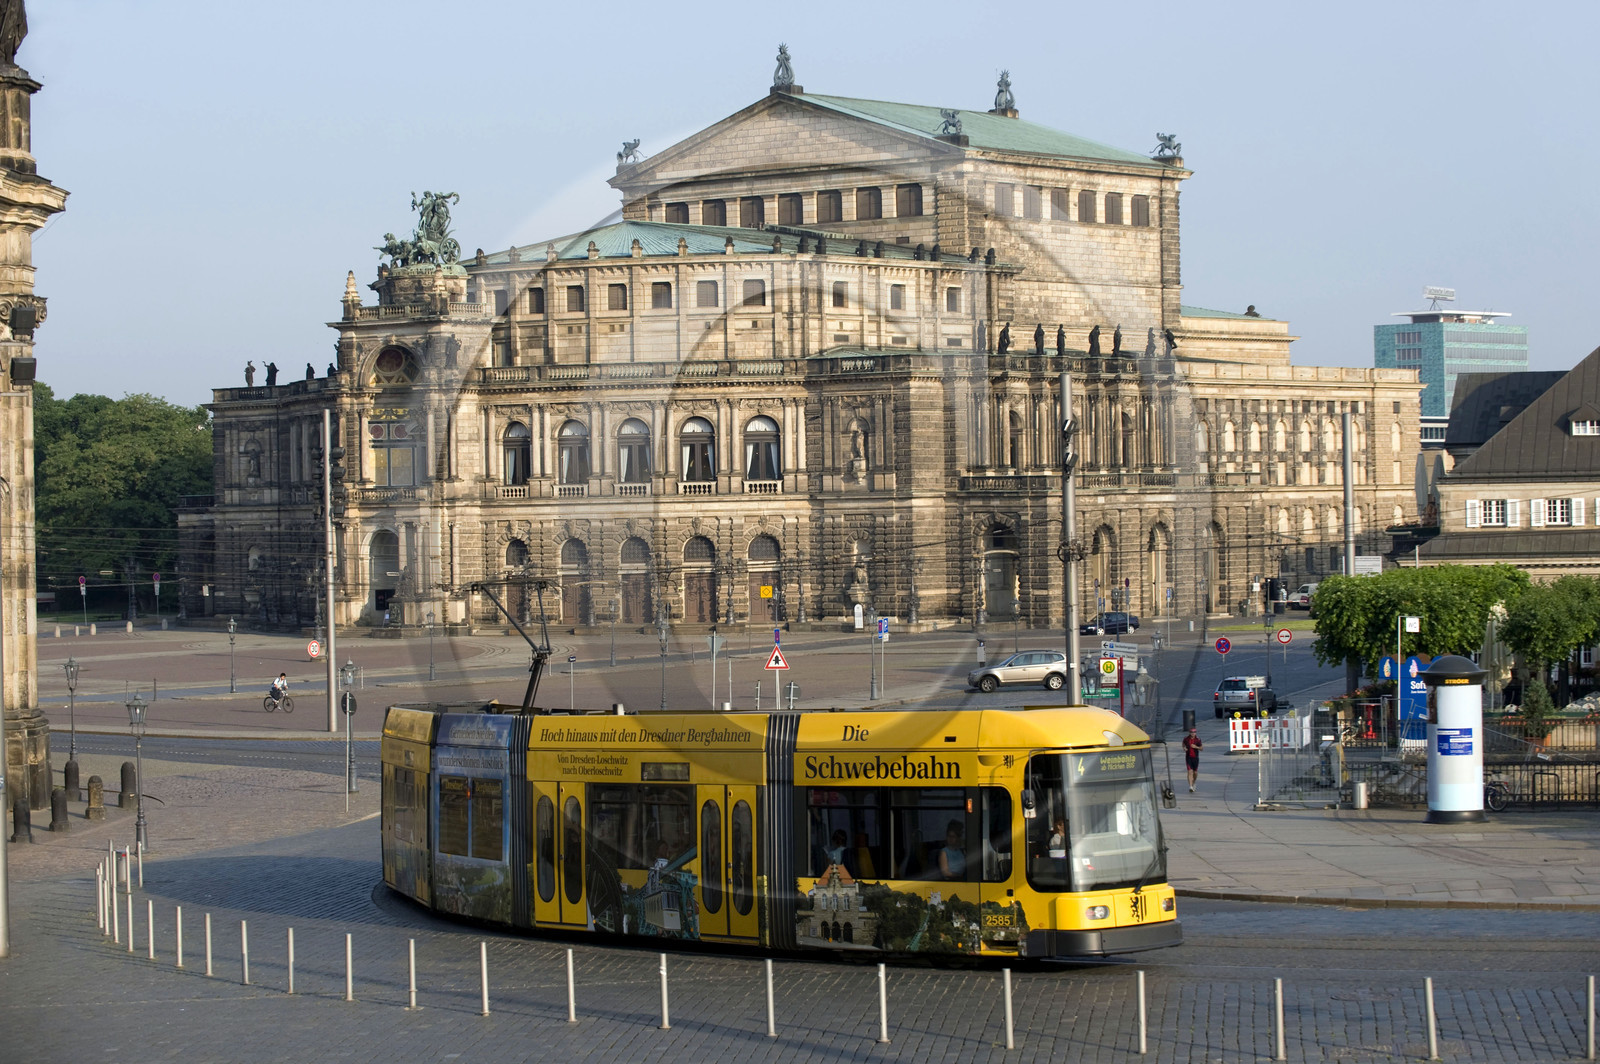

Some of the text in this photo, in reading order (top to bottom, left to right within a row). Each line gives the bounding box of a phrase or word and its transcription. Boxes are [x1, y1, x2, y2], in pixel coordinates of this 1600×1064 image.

[540, 728, 751, 746] Hoch hinaus mit den Dresdner Bergbahnen
[841, 724, 869, 742] Die
[557, 754, 628, 765] Von Dresden-Loschwitz
[805, 755, 962, 780] Schwebebahn
[1077, 757, 1085, 776] 4
[562, 765, 623, 776] nach Oberloschwitz
[986, 915, 1010, 926] 2585
